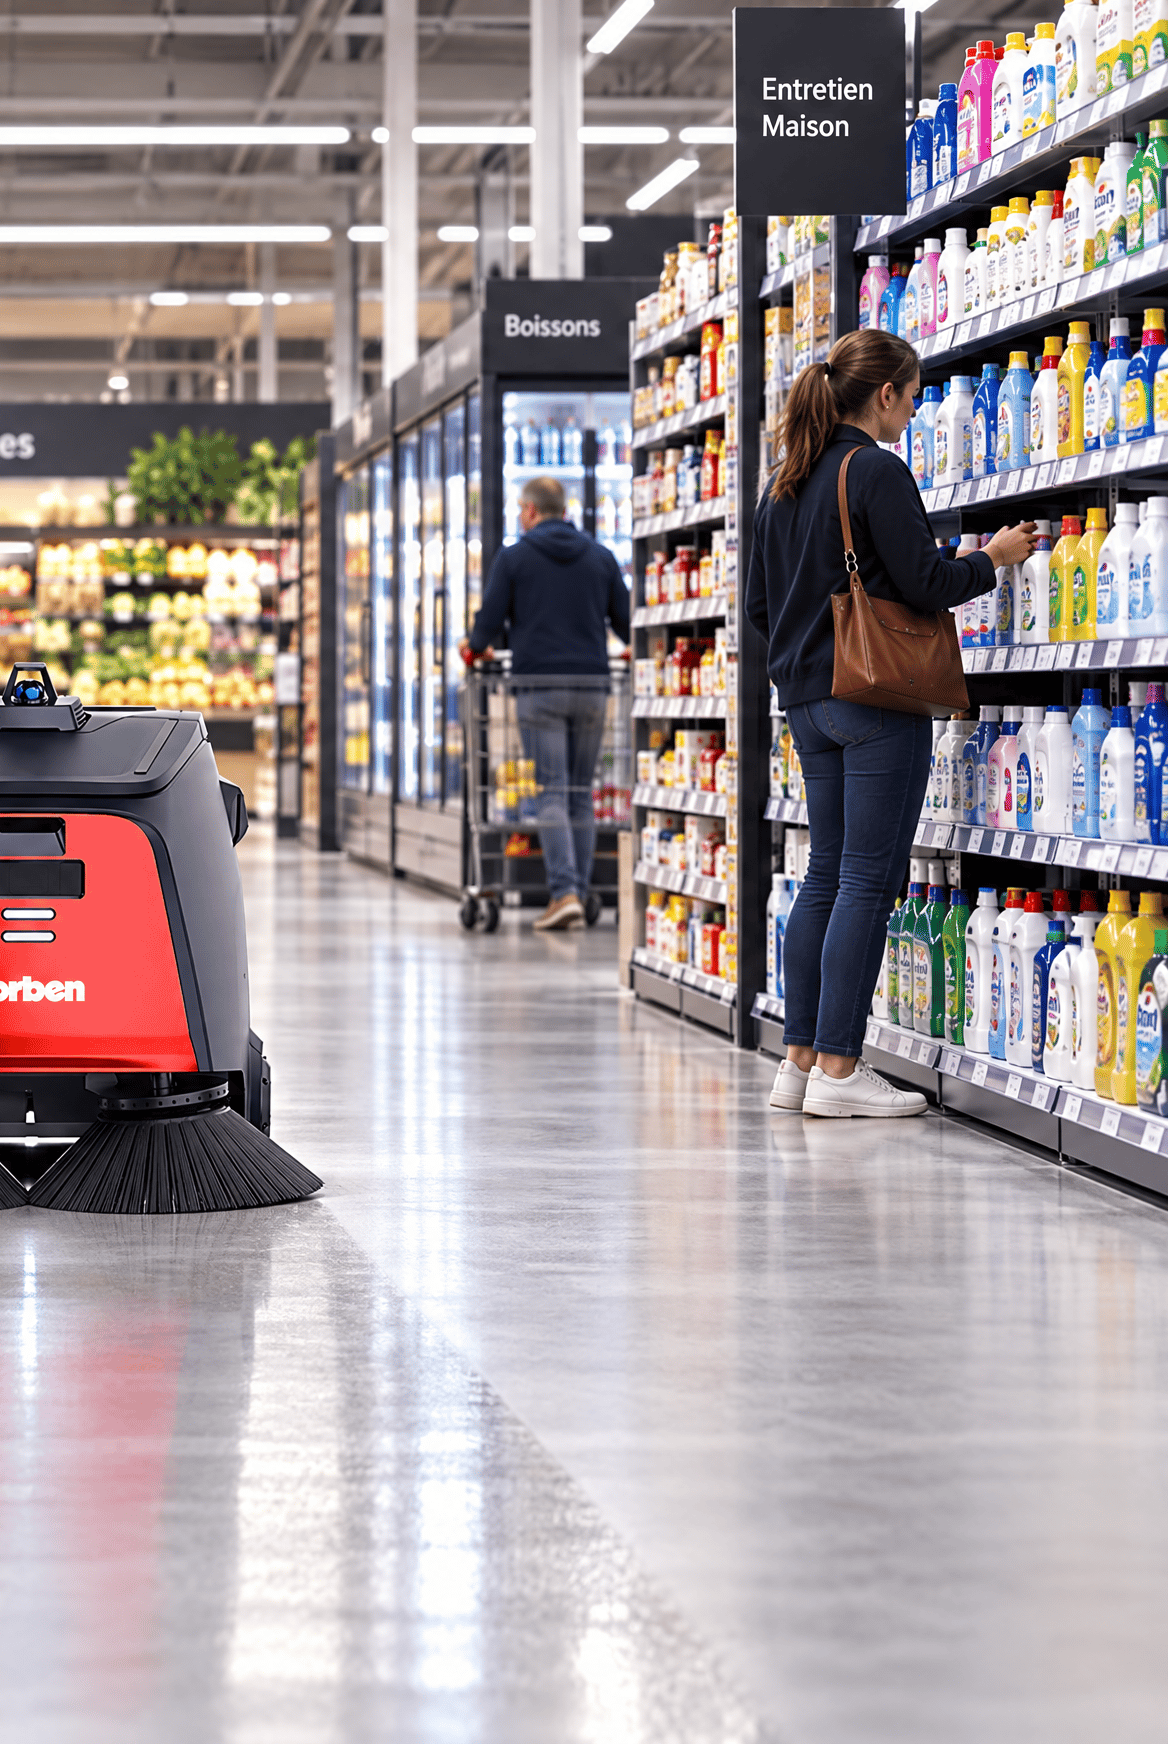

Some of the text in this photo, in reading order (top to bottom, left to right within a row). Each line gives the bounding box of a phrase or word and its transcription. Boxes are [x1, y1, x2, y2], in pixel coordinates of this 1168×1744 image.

[762, 76, 873, 101] Entretien
[762, 113, 849, 138] Maison
[504, 313, 601, 338] Boissons
